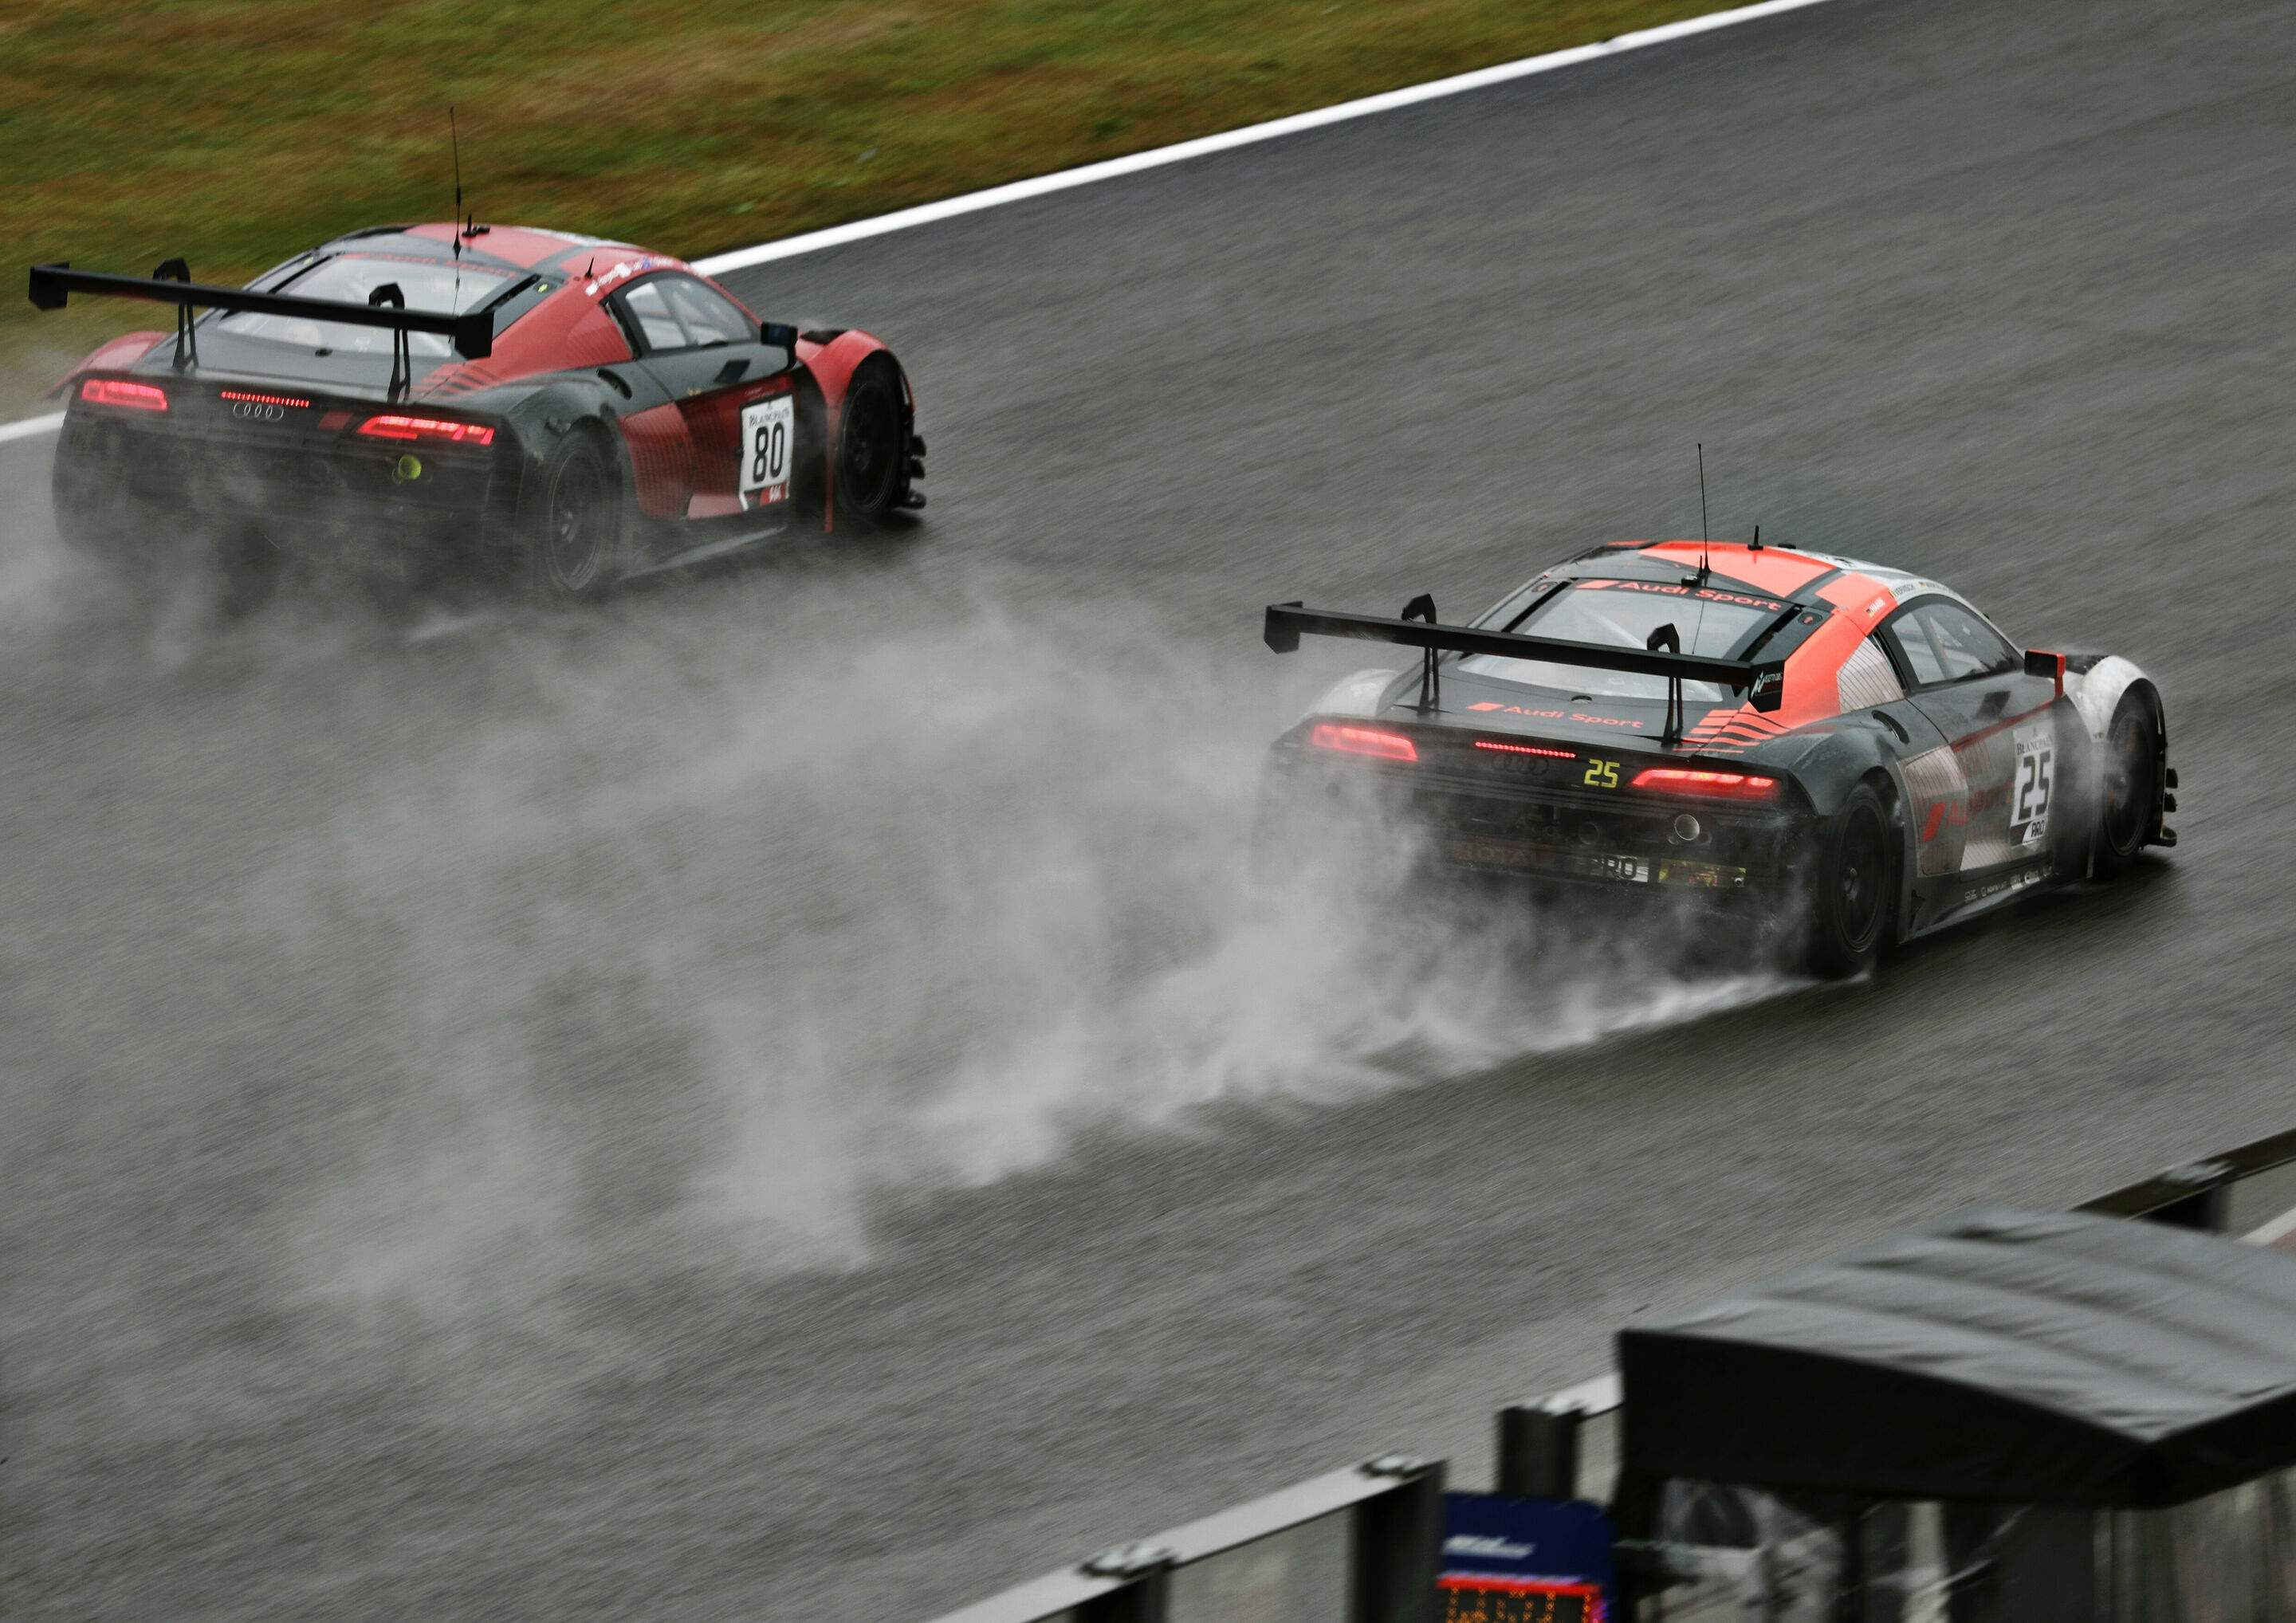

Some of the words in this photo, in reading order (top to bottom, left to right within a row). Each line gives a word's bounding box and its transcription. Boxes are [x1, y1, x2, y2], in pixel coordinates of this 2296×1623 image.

[753, 422, 784, 483] 80
[1617, 582, 1690, 595] Audi
[1694, 588, 1782, 611] Sport
[1503, 705, 1564, 718] Audi
[1568, 713, 1644, 729] Sport
[1583, 758, 1621, 788] 25
[2018, 749, 2051, 821] 25
[2031, 819, 2046, 838] PRO
